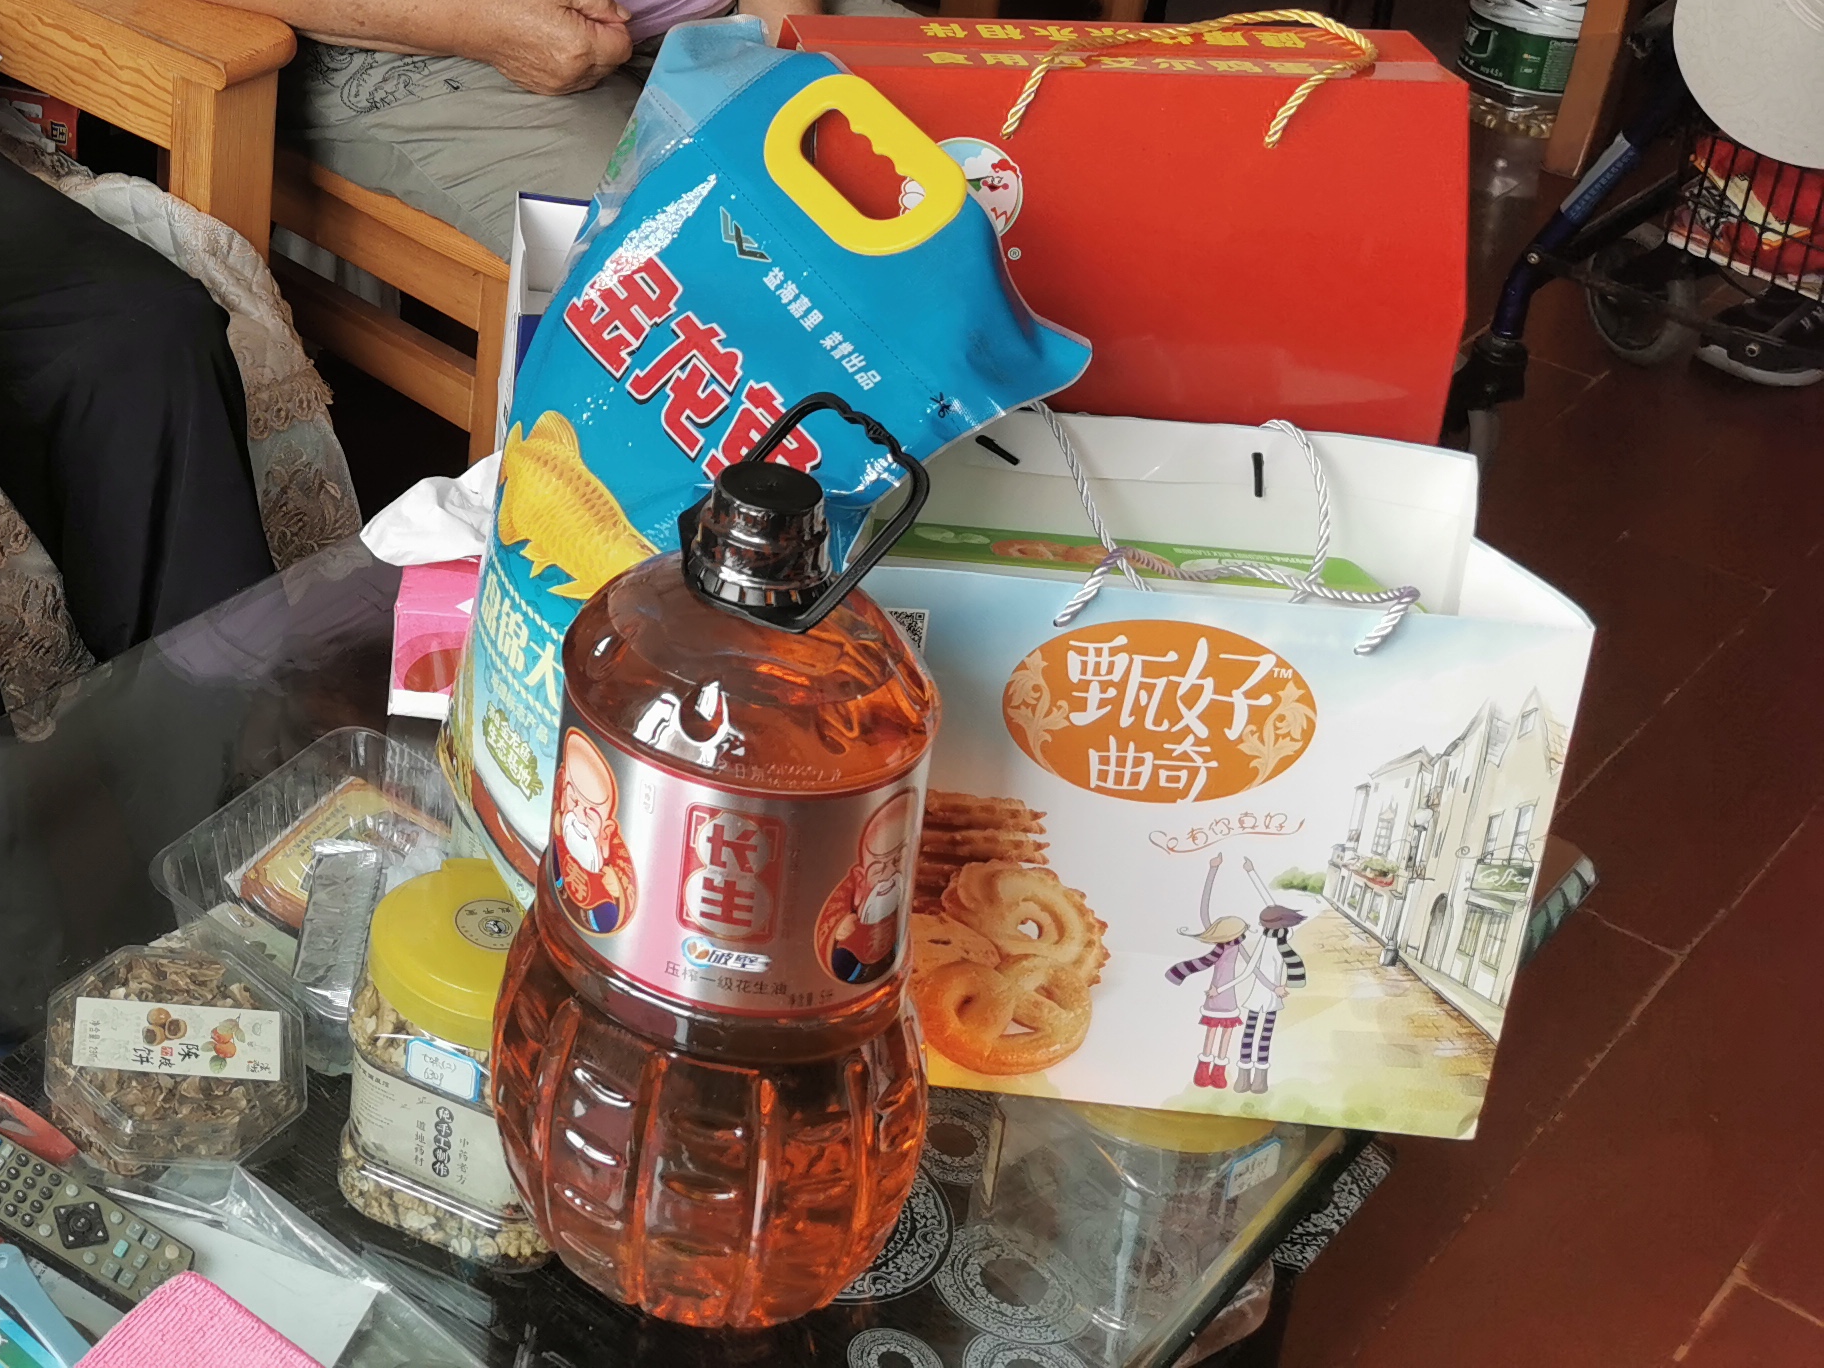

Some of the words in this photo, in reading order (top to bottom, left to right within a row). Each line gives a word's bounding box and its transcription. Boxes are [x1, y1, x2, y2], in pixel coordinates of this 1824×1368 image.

[564, 248, 822, 482] 金龙鱼
[762, 266, 824, 332] 益海嘉里
[819, 331, 883, 392] 荣誉出品
[1067, 634, 1277, 740] 甄好
[1087, 735, 1218, 803] 曲奇
[1186, 811, 1288, 846] 有你真好
[699, 821, 759, 929] 长生
[664, 960, 787, 996] 压榨一级花生油
[433, 1107, 453, 1177] 纯手工制作
